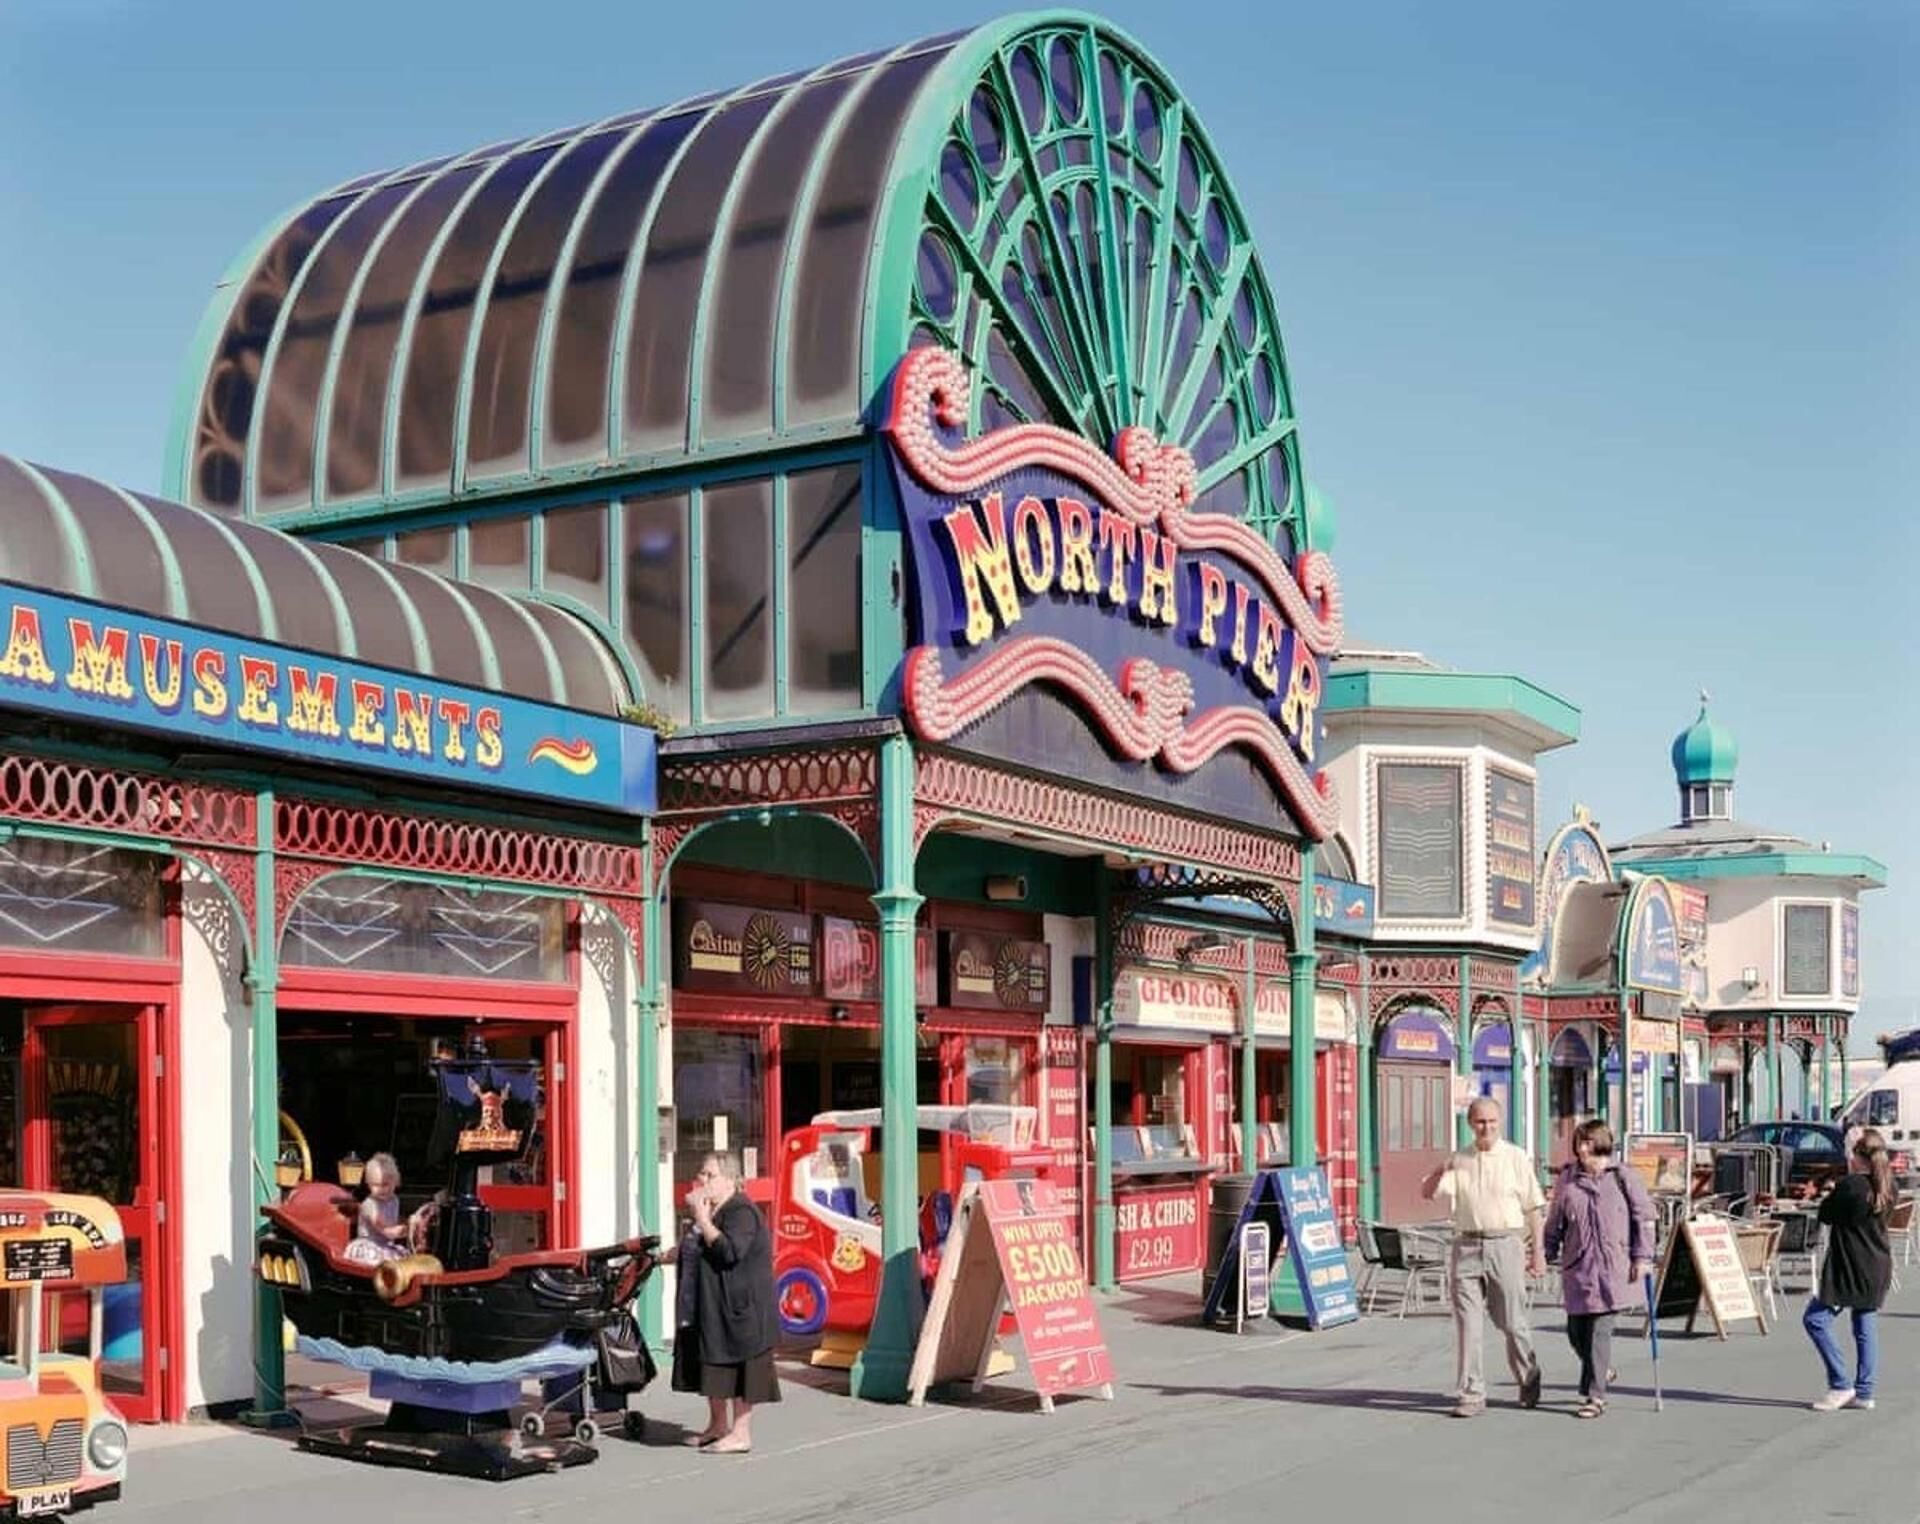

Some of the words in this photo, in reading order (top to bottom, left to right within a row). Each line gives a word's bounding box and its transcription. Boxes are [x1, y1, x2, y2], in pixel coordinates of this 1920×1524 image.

[943, 491, 1178, 647] NORTH
[1199, 561, 1322, 763] PIER
[0, 605, 503, 769] AMUSEMENTS
[690, 920, 742, 954] Casino
[1257, 987, 1289, 1015] DIN
[1118, 1204, 1138, 1232] SH
[1140, 1203, 1153, 1230] &
[1155, 1197, 1196, 1228] CHIPS
[1002, 1223, 1031, 1243] WIN
[1009, 1241, 1077, 1282] £500
[1127, 1235, 1173, 1269] £2.99
[1017, 1278, 1085, 1308] JACKPOT
[31, 1491, 68, 1510] PLAY
